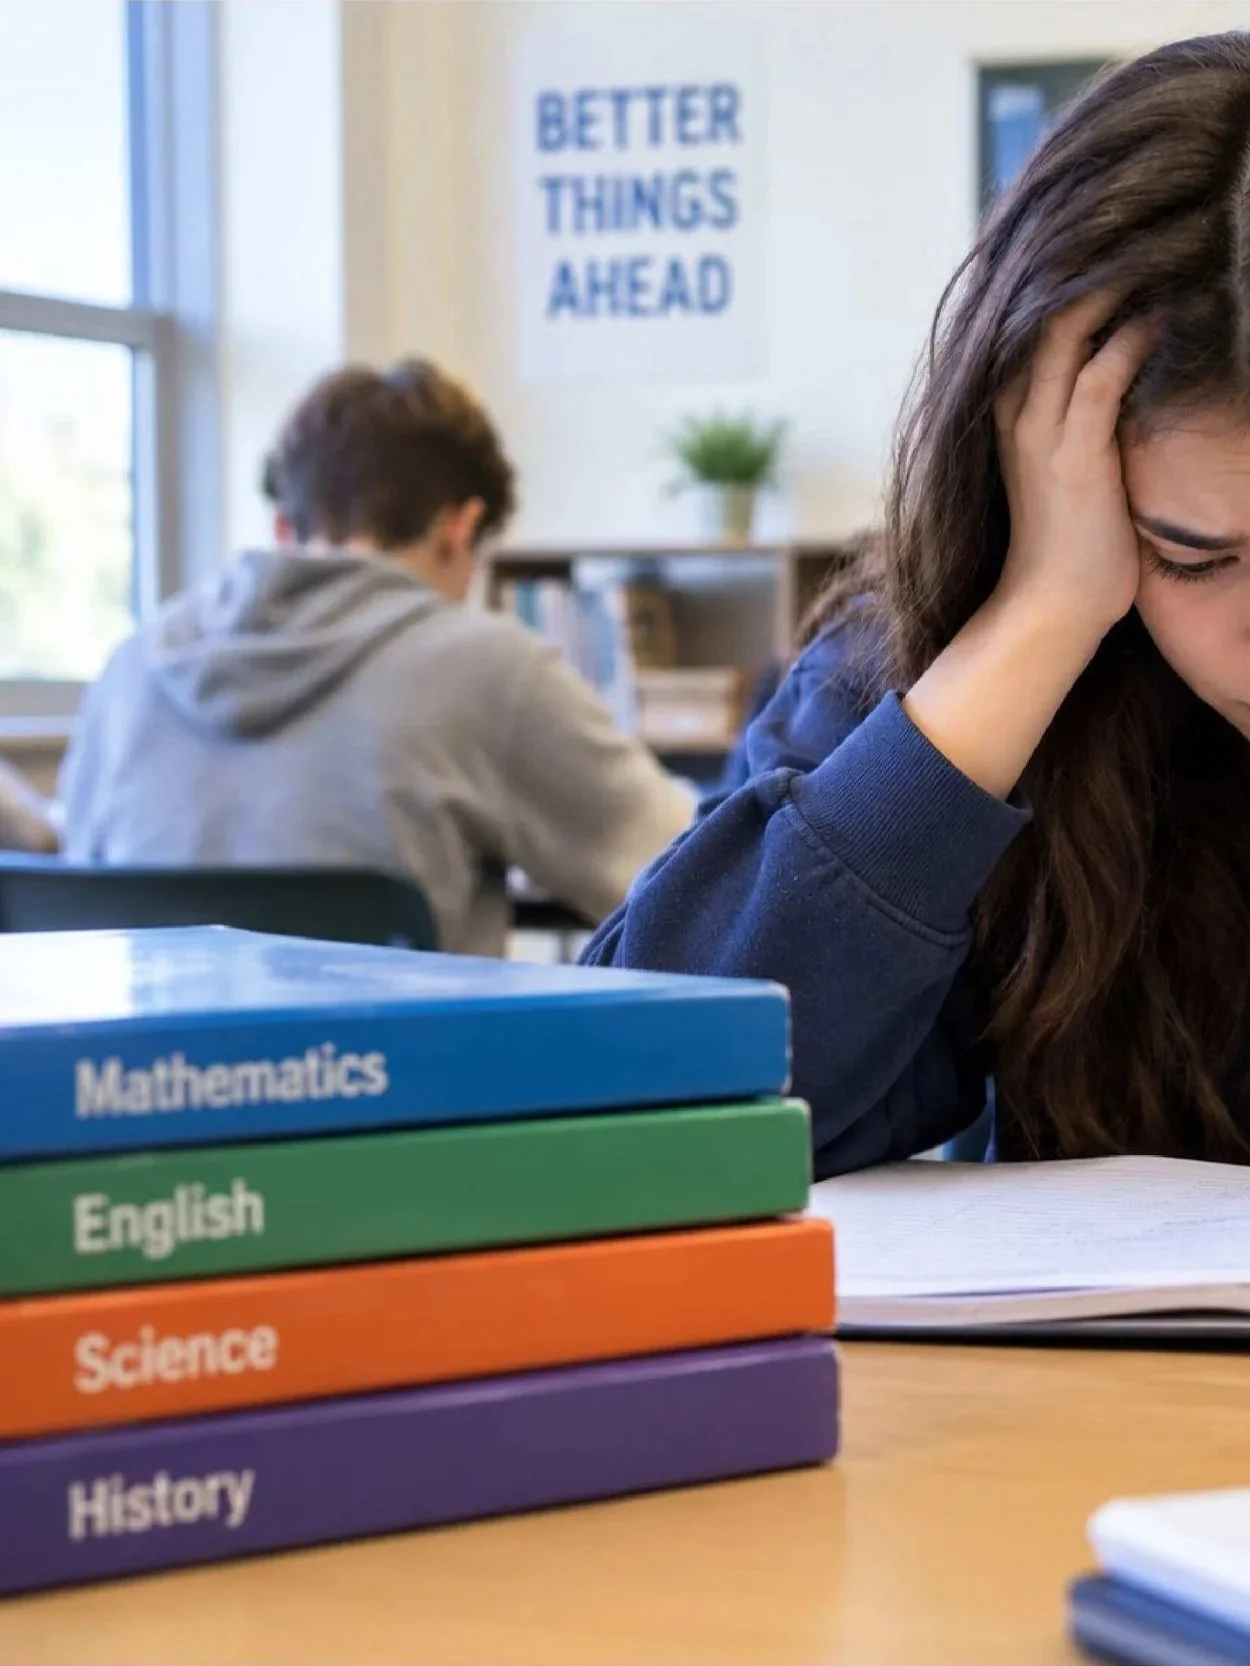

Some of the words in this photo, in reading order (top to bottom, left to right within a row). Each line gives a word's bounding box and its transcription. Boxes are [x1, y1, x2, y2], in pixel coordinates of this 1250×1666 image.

[536, 84, 742, 151] BETTER
[539, 167, 739, 234] THINGS
[546, 254, 733, 321] AHEAD
[74, 1041, 389, 1120] Mathematics
[73, 1177, 265, 1260] English
[73, 1325, 279, 1394] Science
[67, 1469, 255, 1542] History
